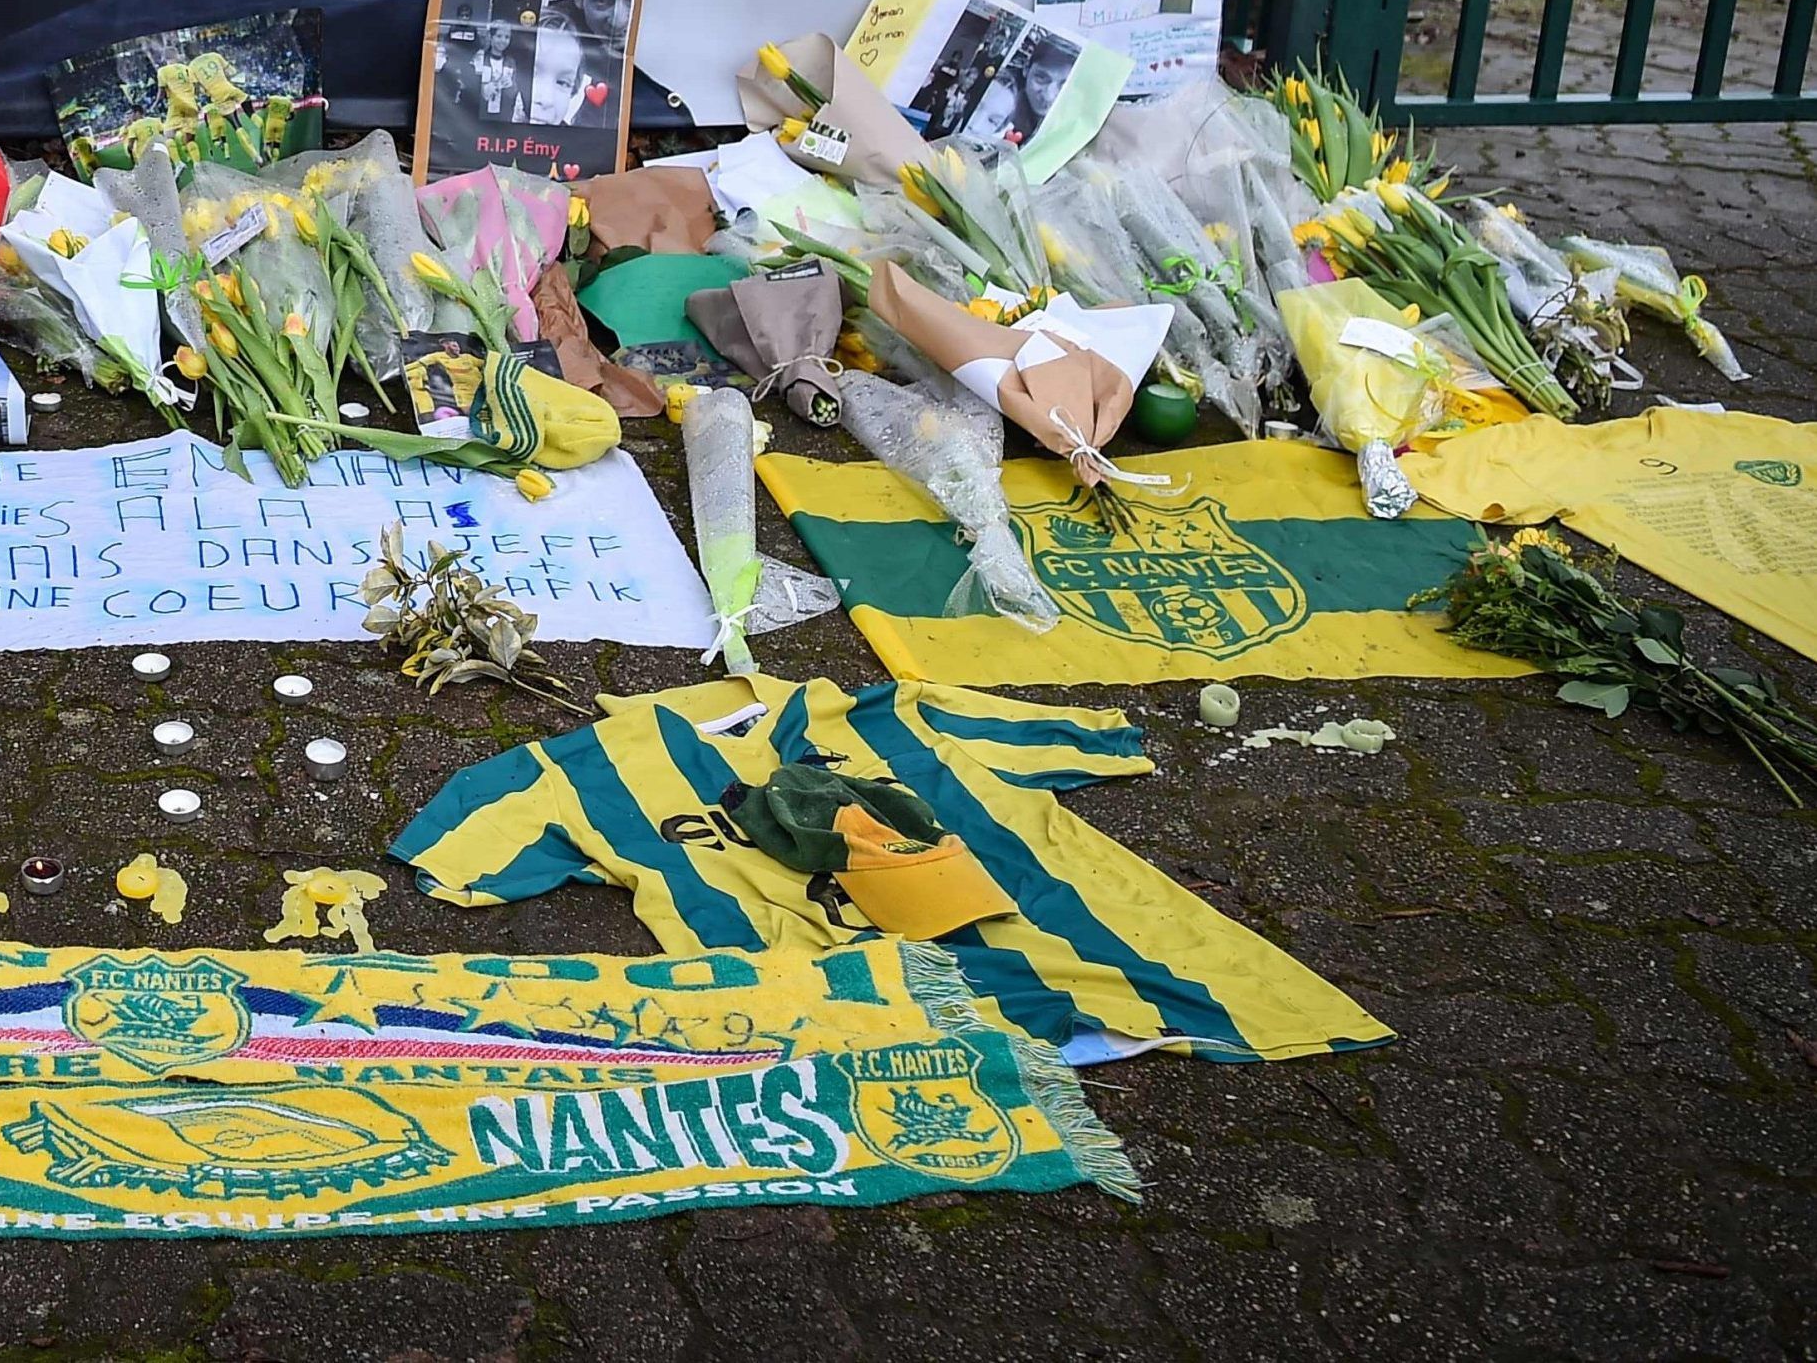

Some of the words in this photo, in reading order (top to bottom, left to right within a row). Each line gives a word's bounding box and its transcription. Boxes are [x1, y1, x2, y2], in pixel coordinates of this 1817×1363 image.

[198, 60, 219, 80] 19
[477, 137, 518, 153] R.I.P
[523, 135, 560, 160] Émy
[198, 537, 372, 569] DANS
[1042, 554, 1095, 577] FC
[1102, 555, 1269, 578] NANTES
[484, 576, 643, 603] AFIK
[133, 970, 223, 991] NANTES
[294, 1064, 658, 1085] NANTAIS
[891, 1048, 970, 1076] NANTES
[467, 1058, 851, 1178] NANTES
[415, 1200, 548, 1225] UNE
[575, 1178, 859, 1215] PASSION
